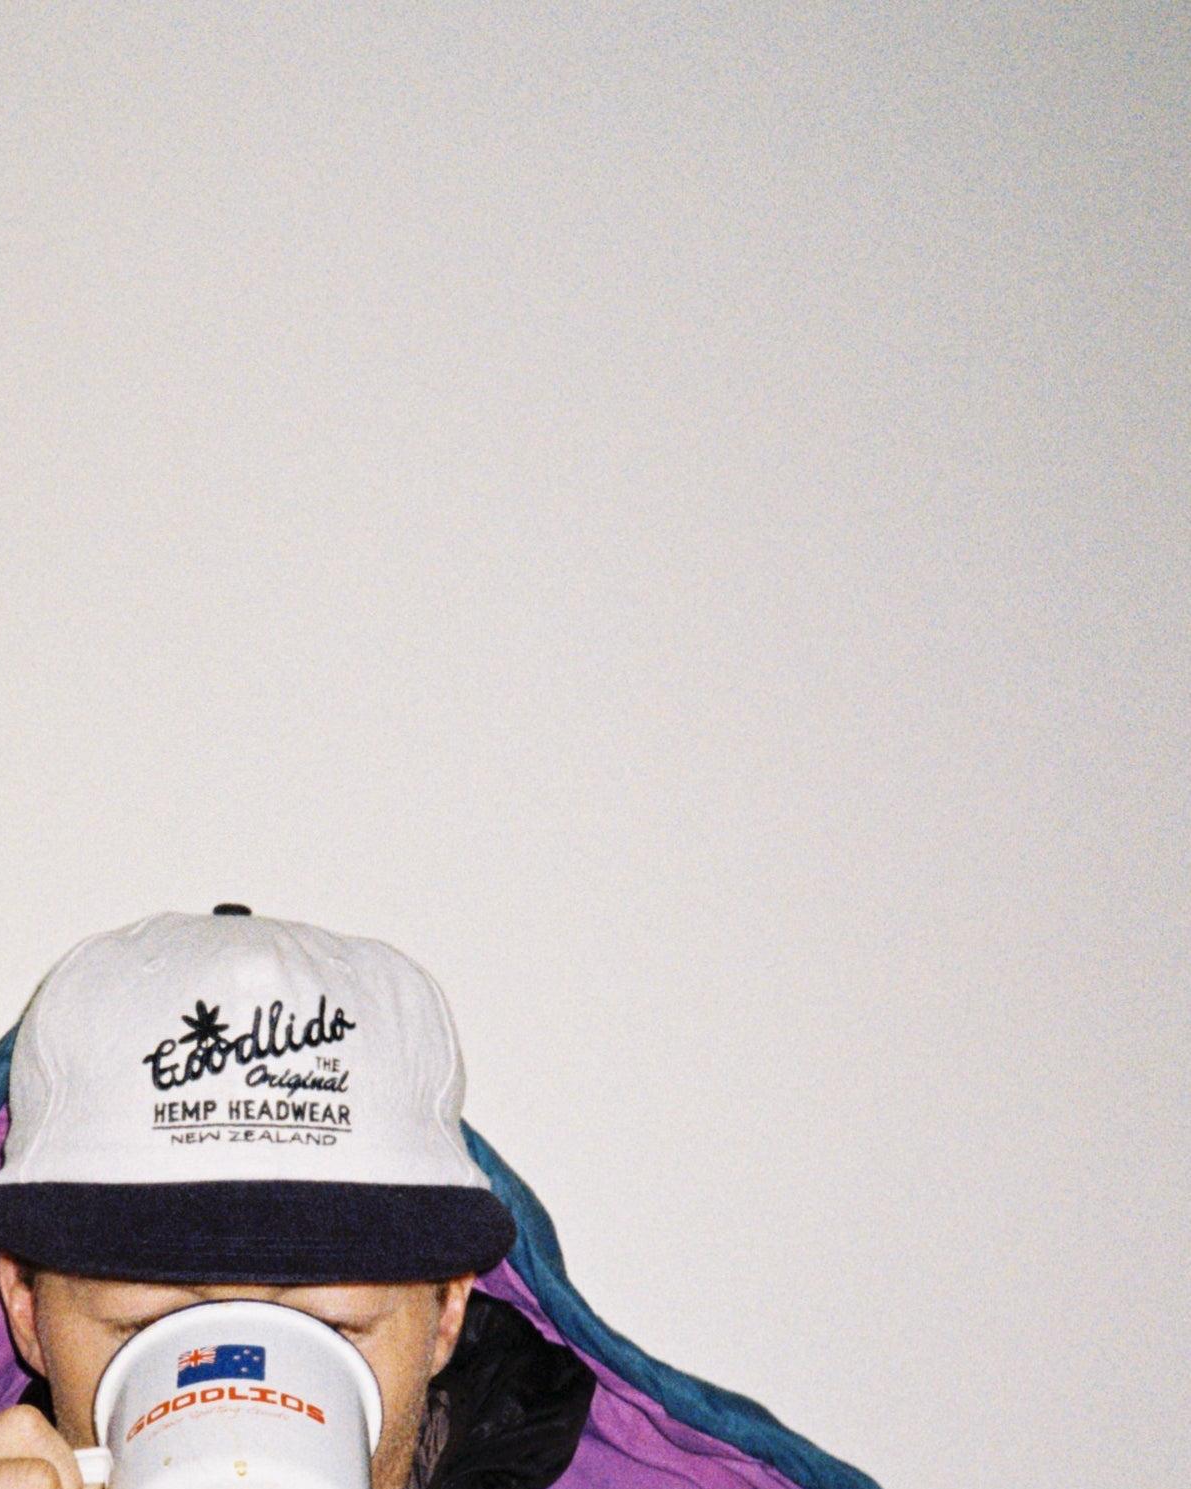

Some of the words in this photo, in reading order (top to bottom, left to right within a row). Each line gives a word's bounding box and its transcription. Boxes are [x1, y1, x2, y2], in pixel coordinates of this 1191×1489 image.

[316, 1056, 341, 1072] THE
[245, 1064, 349, 1097] Original
[153, 1100, 217, 1123] HEMP
[229, 1100, 351, 1125] HEADWEAR
[170, 1130, 220, 1144] NEW
[229, 1130, 337, 1146] ZEALAND
[126, 1386, 326, 1442] GOODLIDS
